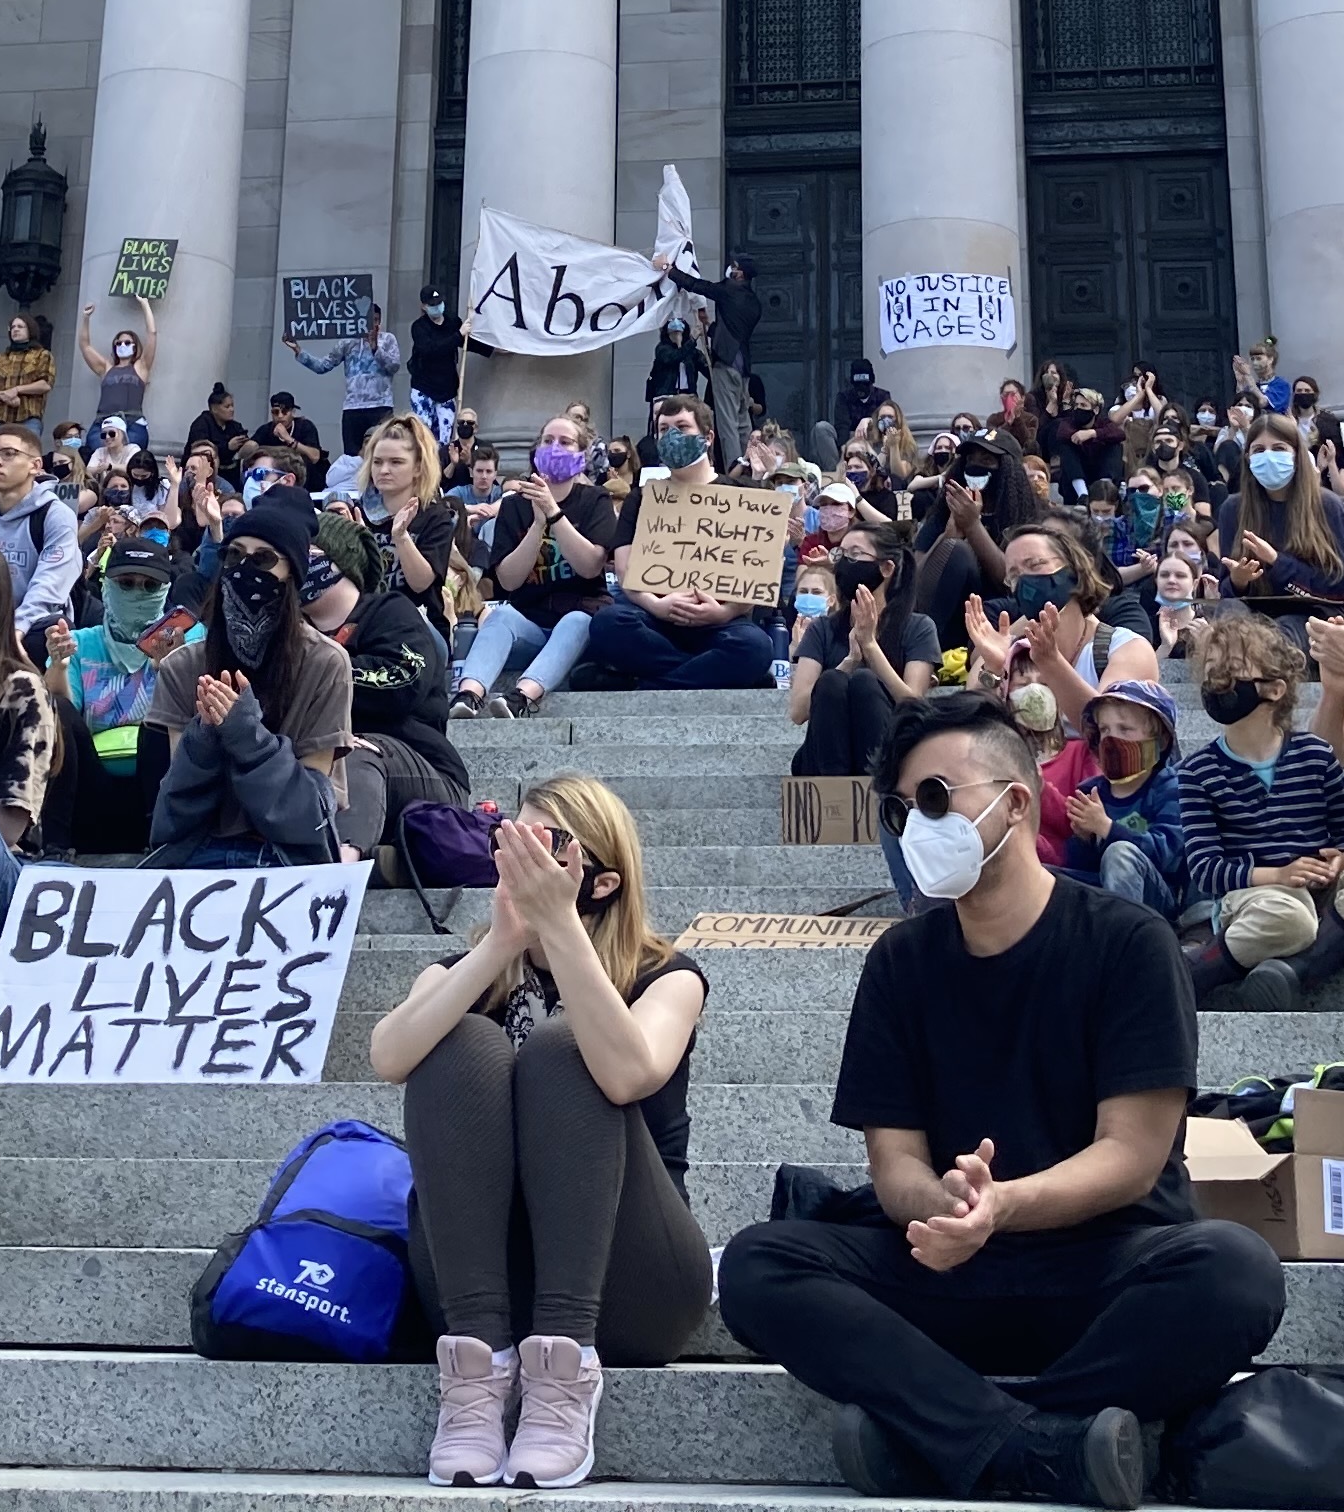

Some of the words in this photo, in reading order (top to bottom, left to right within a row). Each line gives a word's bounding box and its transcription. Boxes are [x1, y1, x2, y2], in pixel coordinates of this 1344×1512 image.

[122, 239, 169, 257] BLACK
[117, 256, 173, 274] LIVES
[110, 271, 169, 299] MATTER
[290, 277, 358, 299] BLACK
[884, 279, 906, 299] NO
[915, 274, 1009, 295] JUSTICE
[297, 299, 356, 319] LIVES
[923, 296, 961, 312] IN
[290, 318, 369, 337] MATTER
[893, 315, 996, 343] CAGES
[651, 484, 680, 504] We
[689, 492, 731, 514] only
[738, 494, 783, 516] have
[672, 541, 738, 565] TAKE
[641, 564, 780, 604] OURSELVES
[10, 876, 306, 963] BLACK
[70, 950, 332, 1024] LIVES
